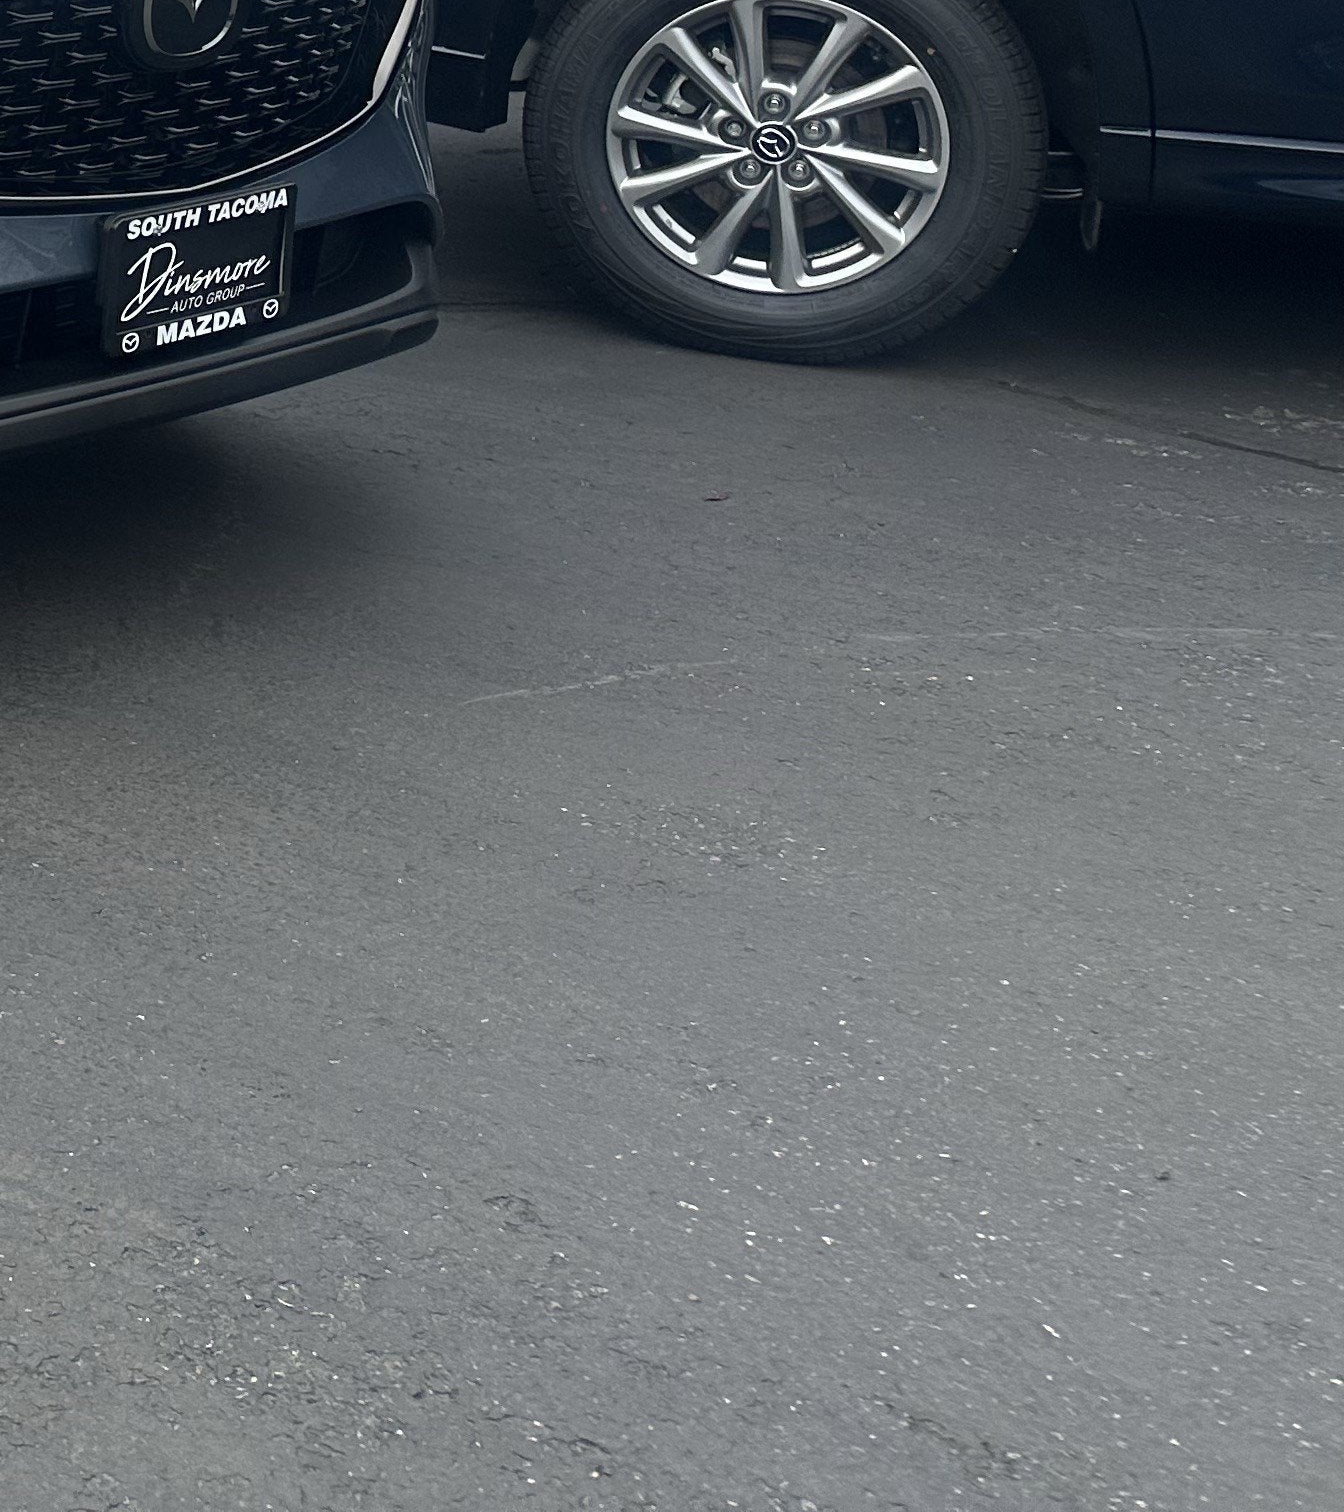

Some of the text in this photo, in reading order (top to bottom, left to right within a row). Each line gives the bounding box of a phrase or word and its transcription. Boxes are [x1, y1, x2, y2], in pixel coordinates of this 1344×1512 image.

[126, 188, 289, 241] SOUTH TACOMA
[119, 242, 272, 323] Dinsmore
[170, 283, 246, 314] AUTO GROUP
[156, 306, 247, 347] MAZDA
